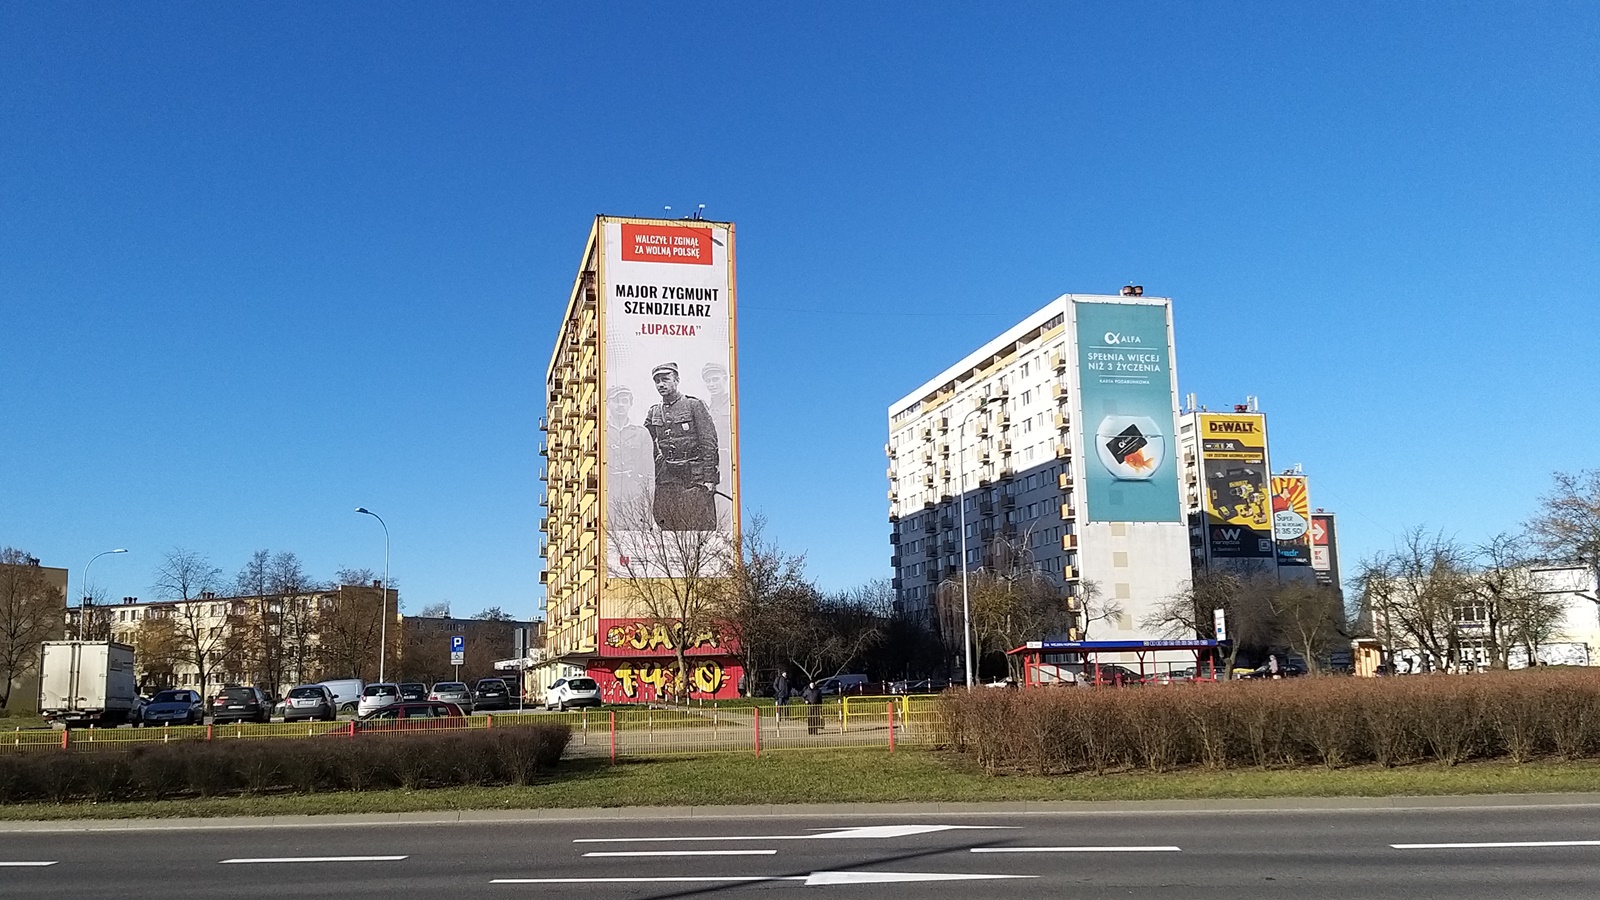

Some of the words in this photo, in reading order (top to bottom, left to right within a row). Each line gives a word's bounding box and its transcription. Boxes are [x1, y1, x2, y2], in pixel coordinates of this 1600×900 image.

[635, 234, 667, 245] WALCZYŁ
[674, 236, 700, 248] ZGINĄŁ
[634, 246, 644, 254] ZA
[646, 246, 672, 257] WOLNĄ
[673, 247, 700, 258] POLSKĘ
[616, 284, 658, 299] MAJOR
[662, 286, 719, 302] ZYGMUNT
[624, 301, 711, 317] SZENDZIELARZ
[1120, 336, 1141, 344] ALFA
[1088, 352, 1125, 361] SPEŁNIA
[1127, 354, 1160, 364] WIĘCEJ
[1088, 361, 1104, 371] NIŻ
[1107, 363, 1113, 371] 3
[1116, 362, 1161, 372] ŻYCZENIA
[453, 637, 462, 648] P
